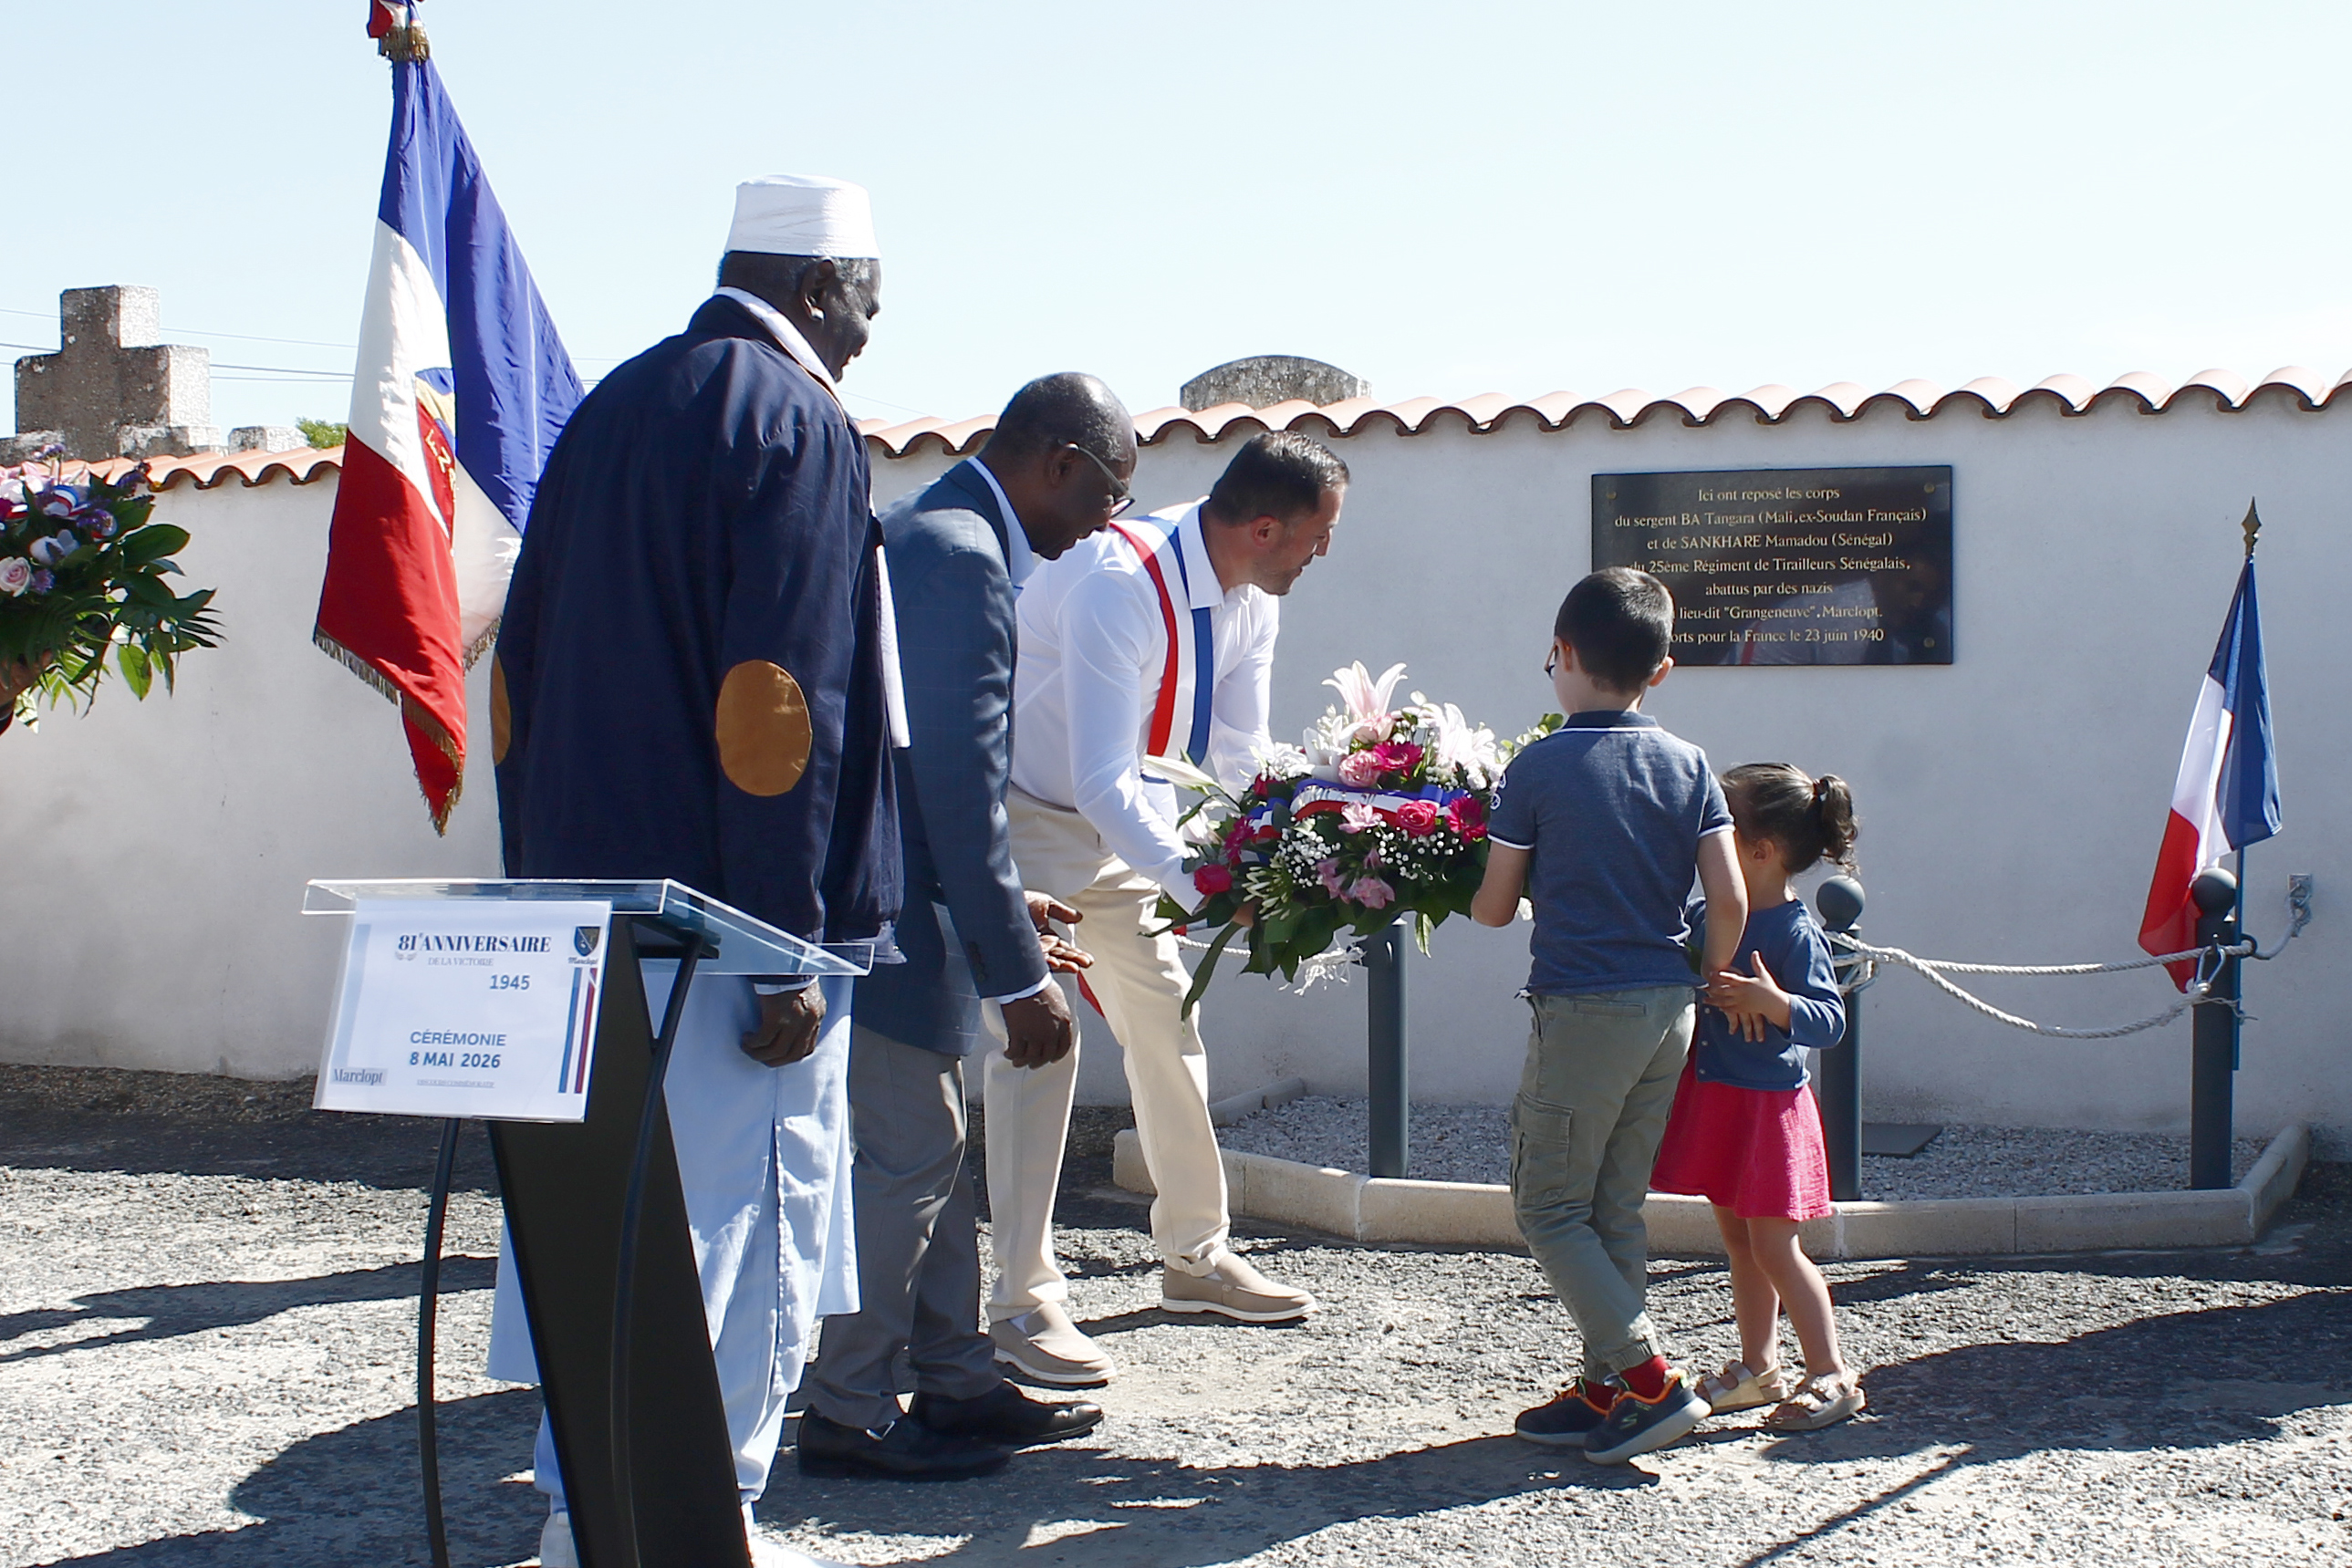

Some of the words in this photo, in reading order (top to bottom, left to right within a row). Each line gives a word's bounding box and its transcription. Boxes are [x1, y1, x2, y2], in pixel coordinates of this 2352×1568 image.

[1698, 488, 1713, 502] Ici
[1717, 489, 1737, 501] ont
[1742, 487, 1782, 503] reposé
[1785, 487, 1802, 500] les
[1806, 489, 1840, 502] corps
[1614, 514, 1631, 528] du
[1634, 515, 1677, 529] sergent
[1681, 513, 1701, 525] BA
[1704, 511, 1755, 527] Tangara
[1868, 506, 1927, 524] Français)
[1647, 538, 1658, 550] et
[1662, 536, 1677, 549] de
[1681, 535, 1762, 549] SANKHARE
[1765, 534, 1828, 547] Mamadou
[1831, 531, 1893, 548] (Sénégal)
[1649, 559, 1690, 574] 25ème
[1693, 558, 1750, 575] Régiment
[1754, 558, 1769, 572] de
[1773, 557, 1837, 572] Tirailleurs
[1839, 556, 1911, 573] Sénégalais,
[1705, 583, 1750, 597] abattus
[1754, 584, 1774, 597] par
[1776, 581, 1798, 595] des
[1801, 581, 1834, 594] nazis
[1680, 607, 1721, 619] lieu-dit
[1670, 631, 1694, 643] orts
[1698, 631, 1726, 645] pour
[1729, 629, 1740, 643] la
[1744, 629, 1786, 643] France
[1790, 629, 1801, 642] le
[1805, 628, 1821, 642] 23
[1822, 628, 1847, 645] juin
[1853, 628, 1885, 642] 1940
[489, 973, 531, 991] 1945
[410, 1028, 507, 1047] CÉRÉMONIE
[410, 1051, 420, 1066] 8
[422, 1051, 454, 1067] MAI
[460, 1052, 502, 1069] 2026
[334, 1067, 383, 1086] Marclopt
